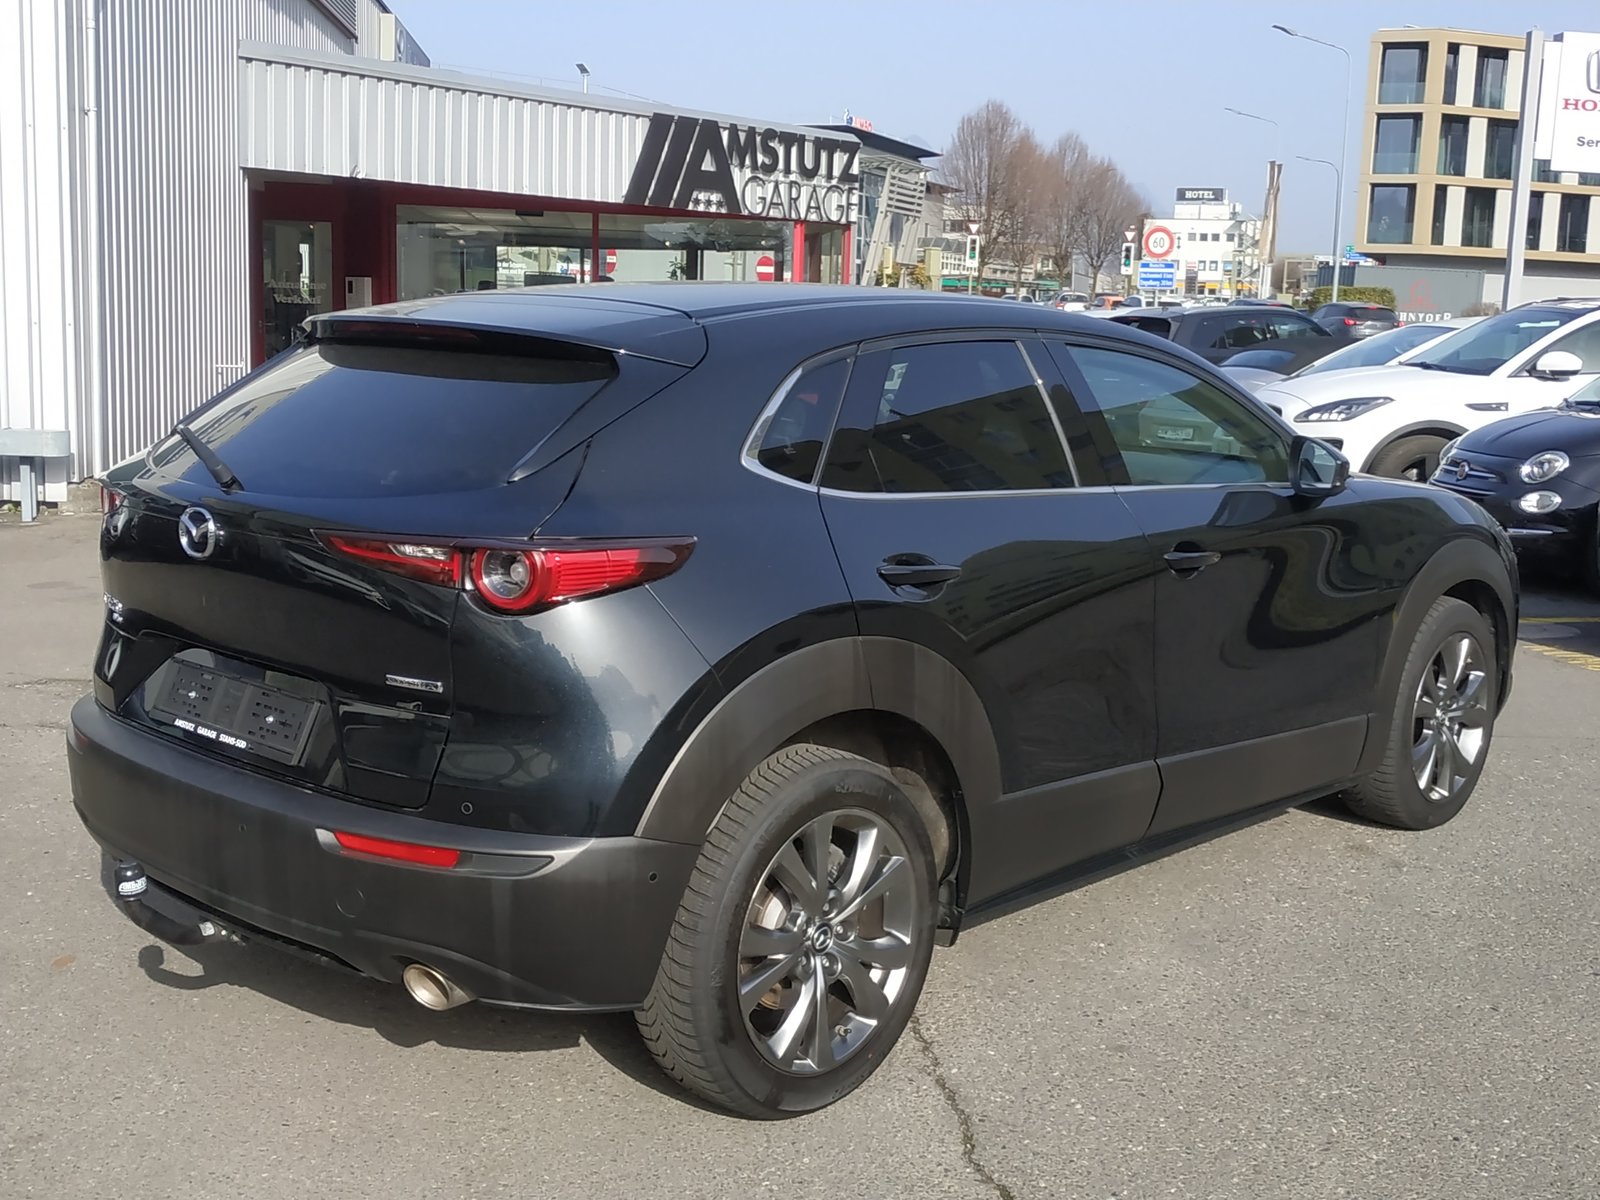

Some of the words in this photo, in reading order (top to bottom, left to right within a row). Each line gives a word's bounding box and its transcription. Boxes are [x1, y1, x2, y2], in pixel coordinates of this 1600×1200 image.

[1562, 98, 1600, 112] HO
[673, 117, 862, 213] AMSTUTZ
[741, 175, 858, 224] GARAGE
[1184, 190, 1216, 199] HOTEL
[1152, 237, 1165, 249] 60
[273, 294, 322, 305] Verkauf
